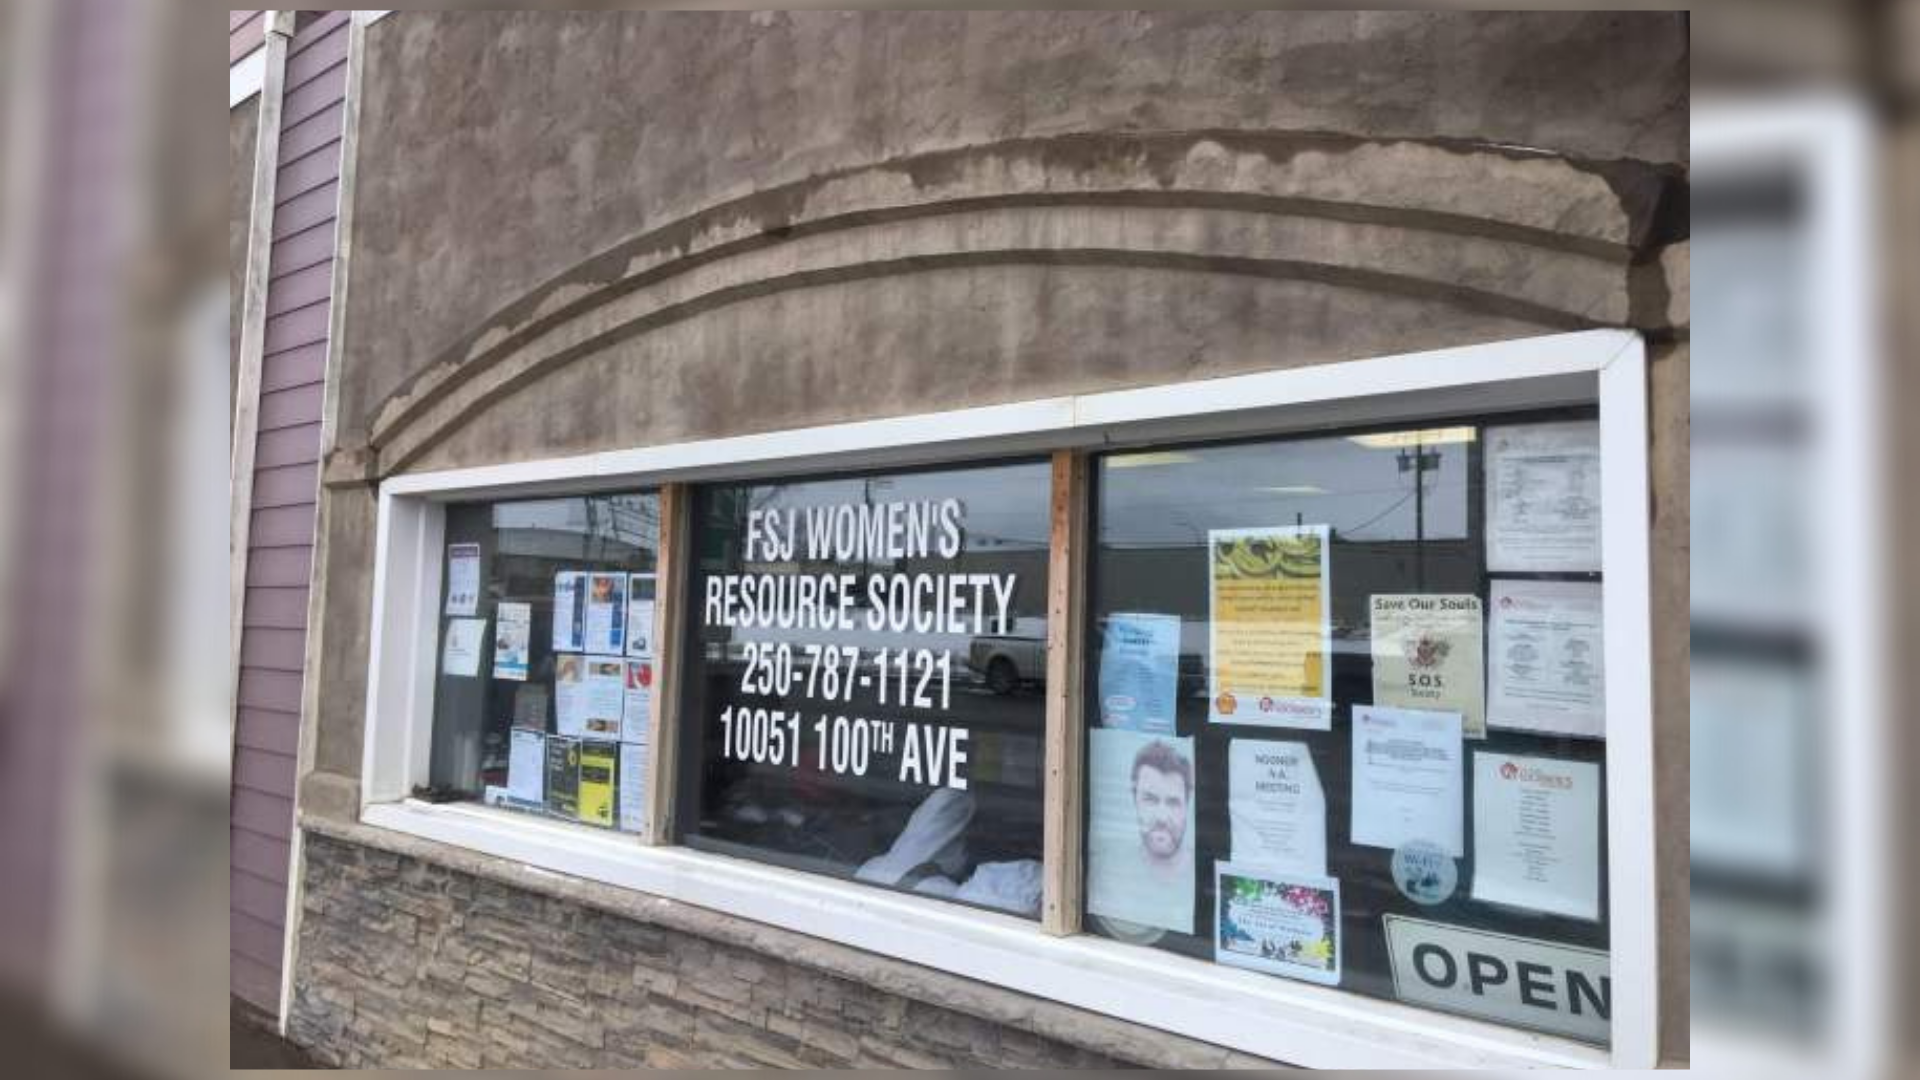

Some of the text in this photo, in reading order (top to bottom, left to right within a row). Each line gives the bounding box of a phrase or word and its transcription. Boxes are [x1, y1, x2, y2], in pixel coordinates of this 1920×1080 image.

[746, 498, 962, 562] FSJ WOMEN'S
[705, 573, 1017, 635] RESOURCE SOCIETY
[1374, 597, 1479, 612] Save Our Souls
[741, 642, 951, 710] 250-787-1121
[720, 705, 801, 767] 10051
[814, 714, 894, 777] 100TH
[899, 722, 970, 790] AVE
[1255, 781, 1301, 795] MEETING
[1412, 942, 1611, 1020] OPEN
